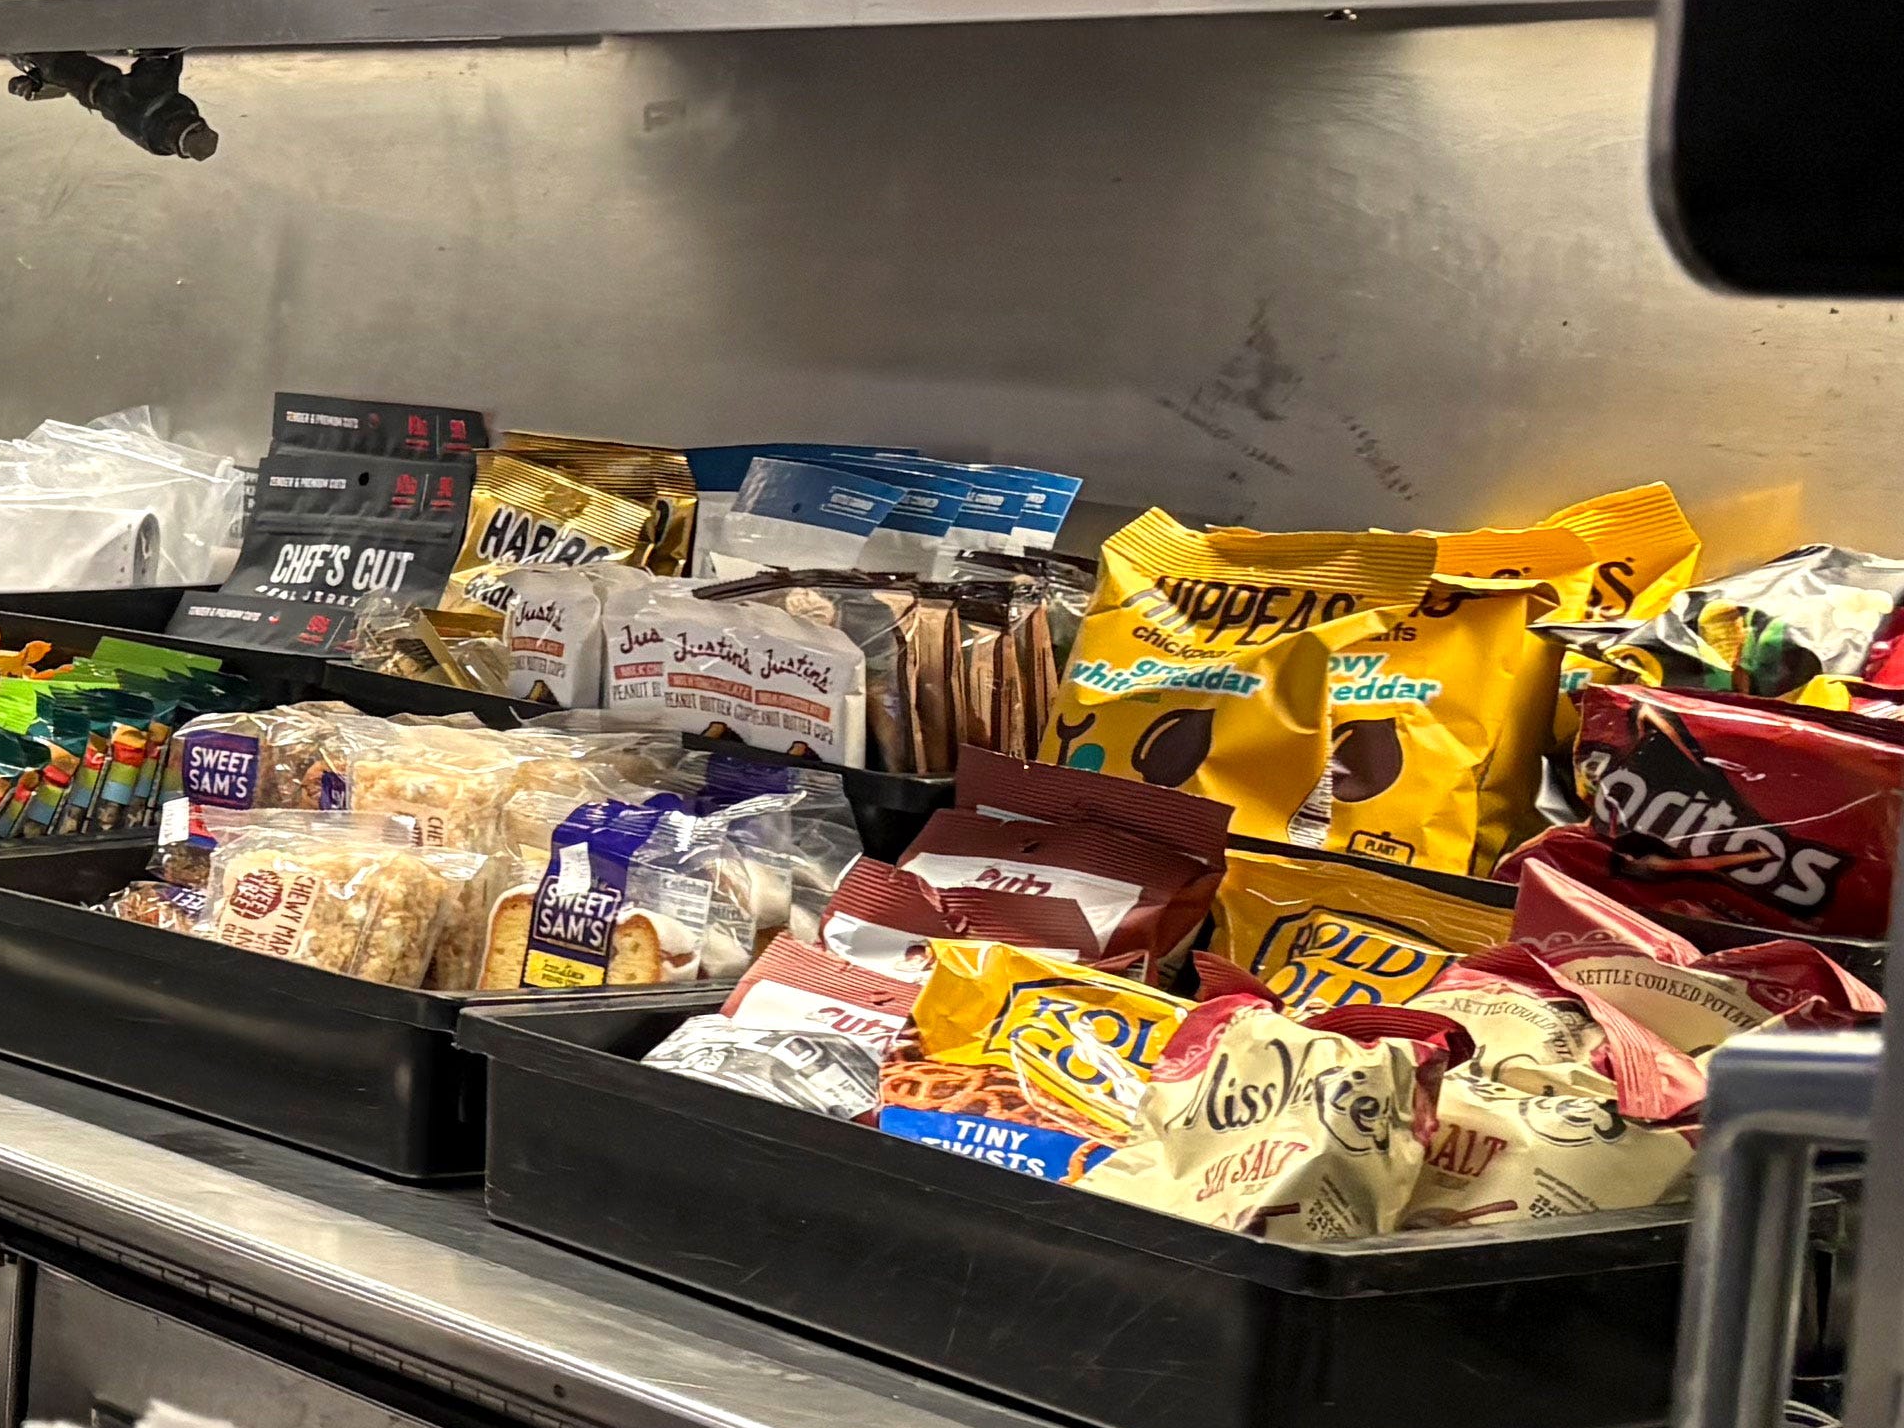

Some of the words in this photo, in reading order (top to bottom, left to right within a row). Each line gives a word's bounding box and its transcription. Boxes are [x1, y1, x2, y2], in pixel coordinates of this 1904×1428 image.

[269, 543, 351, 587] CHEF'S
[351, 549, 414, 593] CUT
[302, 590, 359, 608] JERKY
[673, 633, 752, 675] Justin's
[760, 648, 833, 694] Justin's
[190, 746, 253, 773] SWEET
[189, 771, 248, 799] SAM'S
[1364, 839, 1397, 855] PLANT
[543, 882, 615, 919] SWEET
[537, 908, 608, 948] SAM'S
[1291, 921, 1426, 977] ROLD
[1575, 969, 1633, 988] KETTLE
[1635, 974, 1700, 1002] COOKED
[956, 1119, 1030, 1150] TINY
[1424, 1122, 1508, 1178] ALT
[1232, 1139, 1309, 1183] SALT
